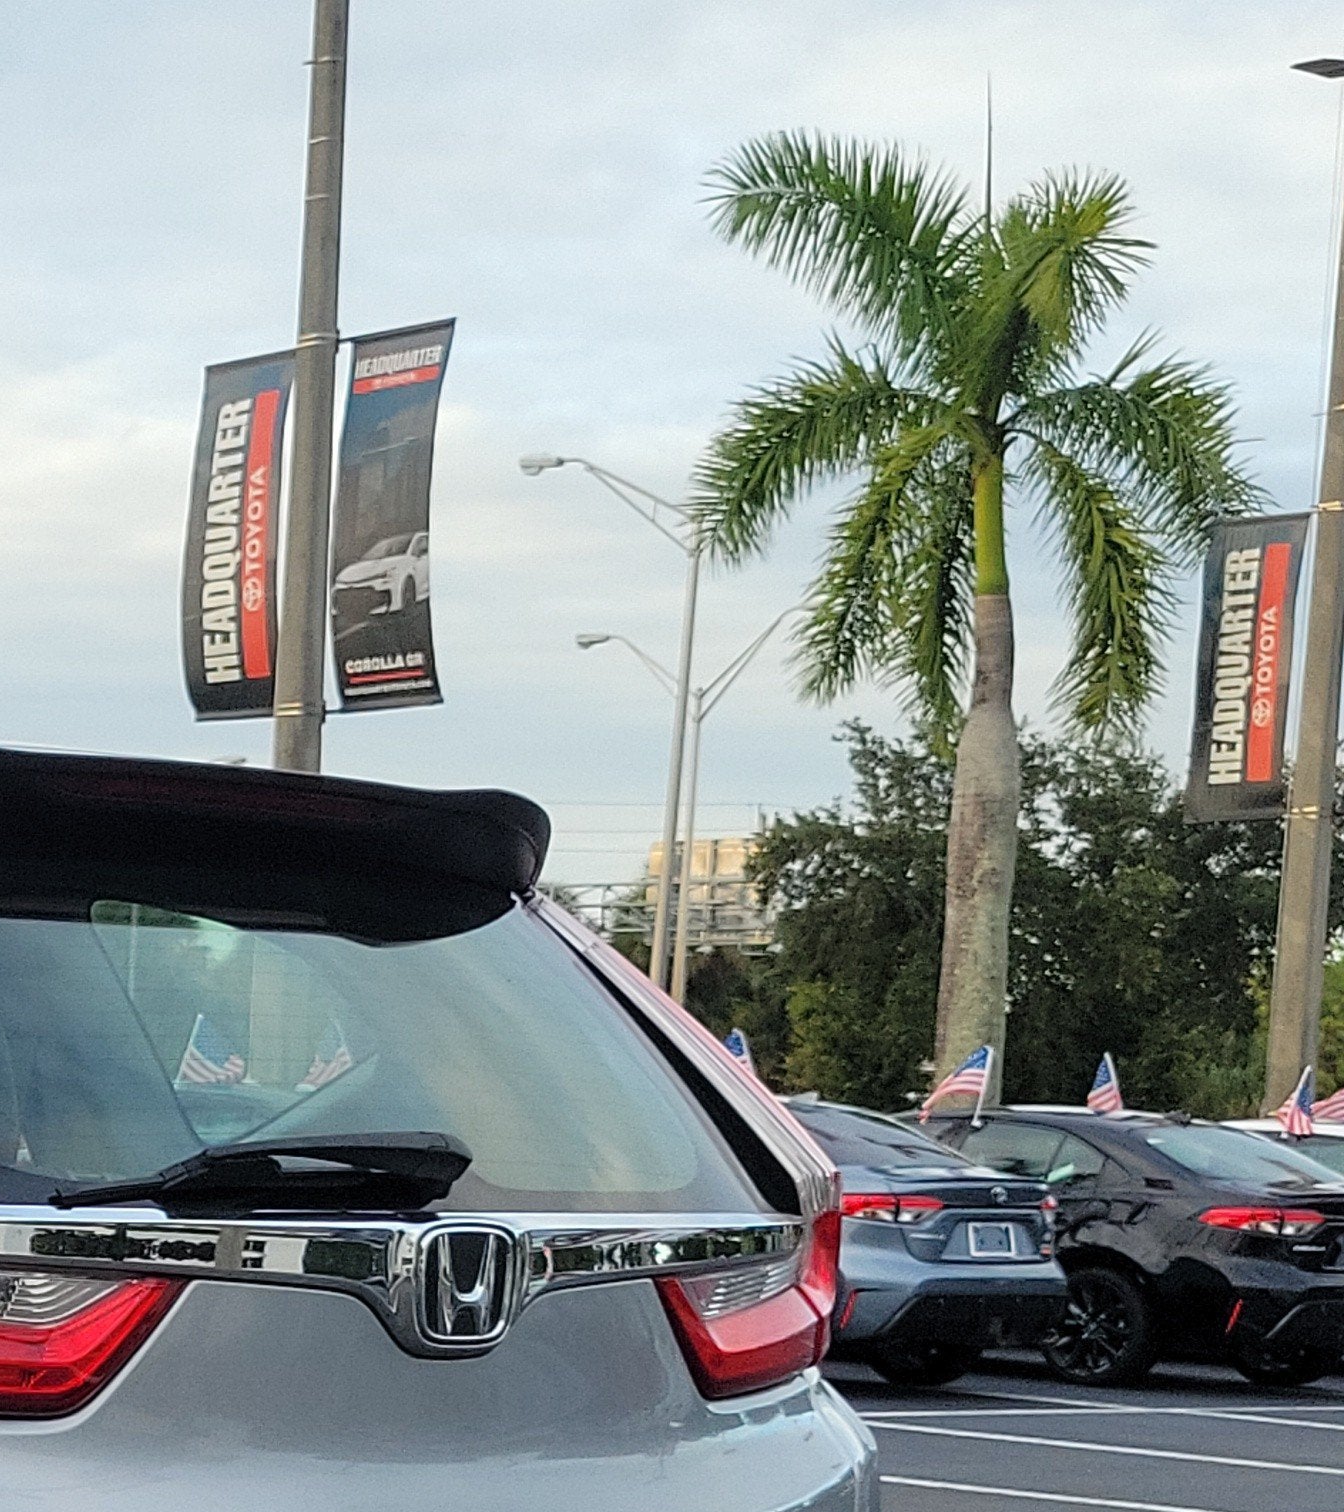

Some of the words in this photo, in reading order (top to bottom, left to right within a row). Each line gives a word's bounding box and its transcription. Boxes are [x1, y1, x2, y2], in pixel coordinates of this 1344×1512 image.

[202, 398, 252, 685] HEADQUARTER
[244, 466, 267, 576] TOYOTA
[1208, 548, 1260, 785] HEADQUARTER
[1256, 606, 1278, 694] TOYOTA
